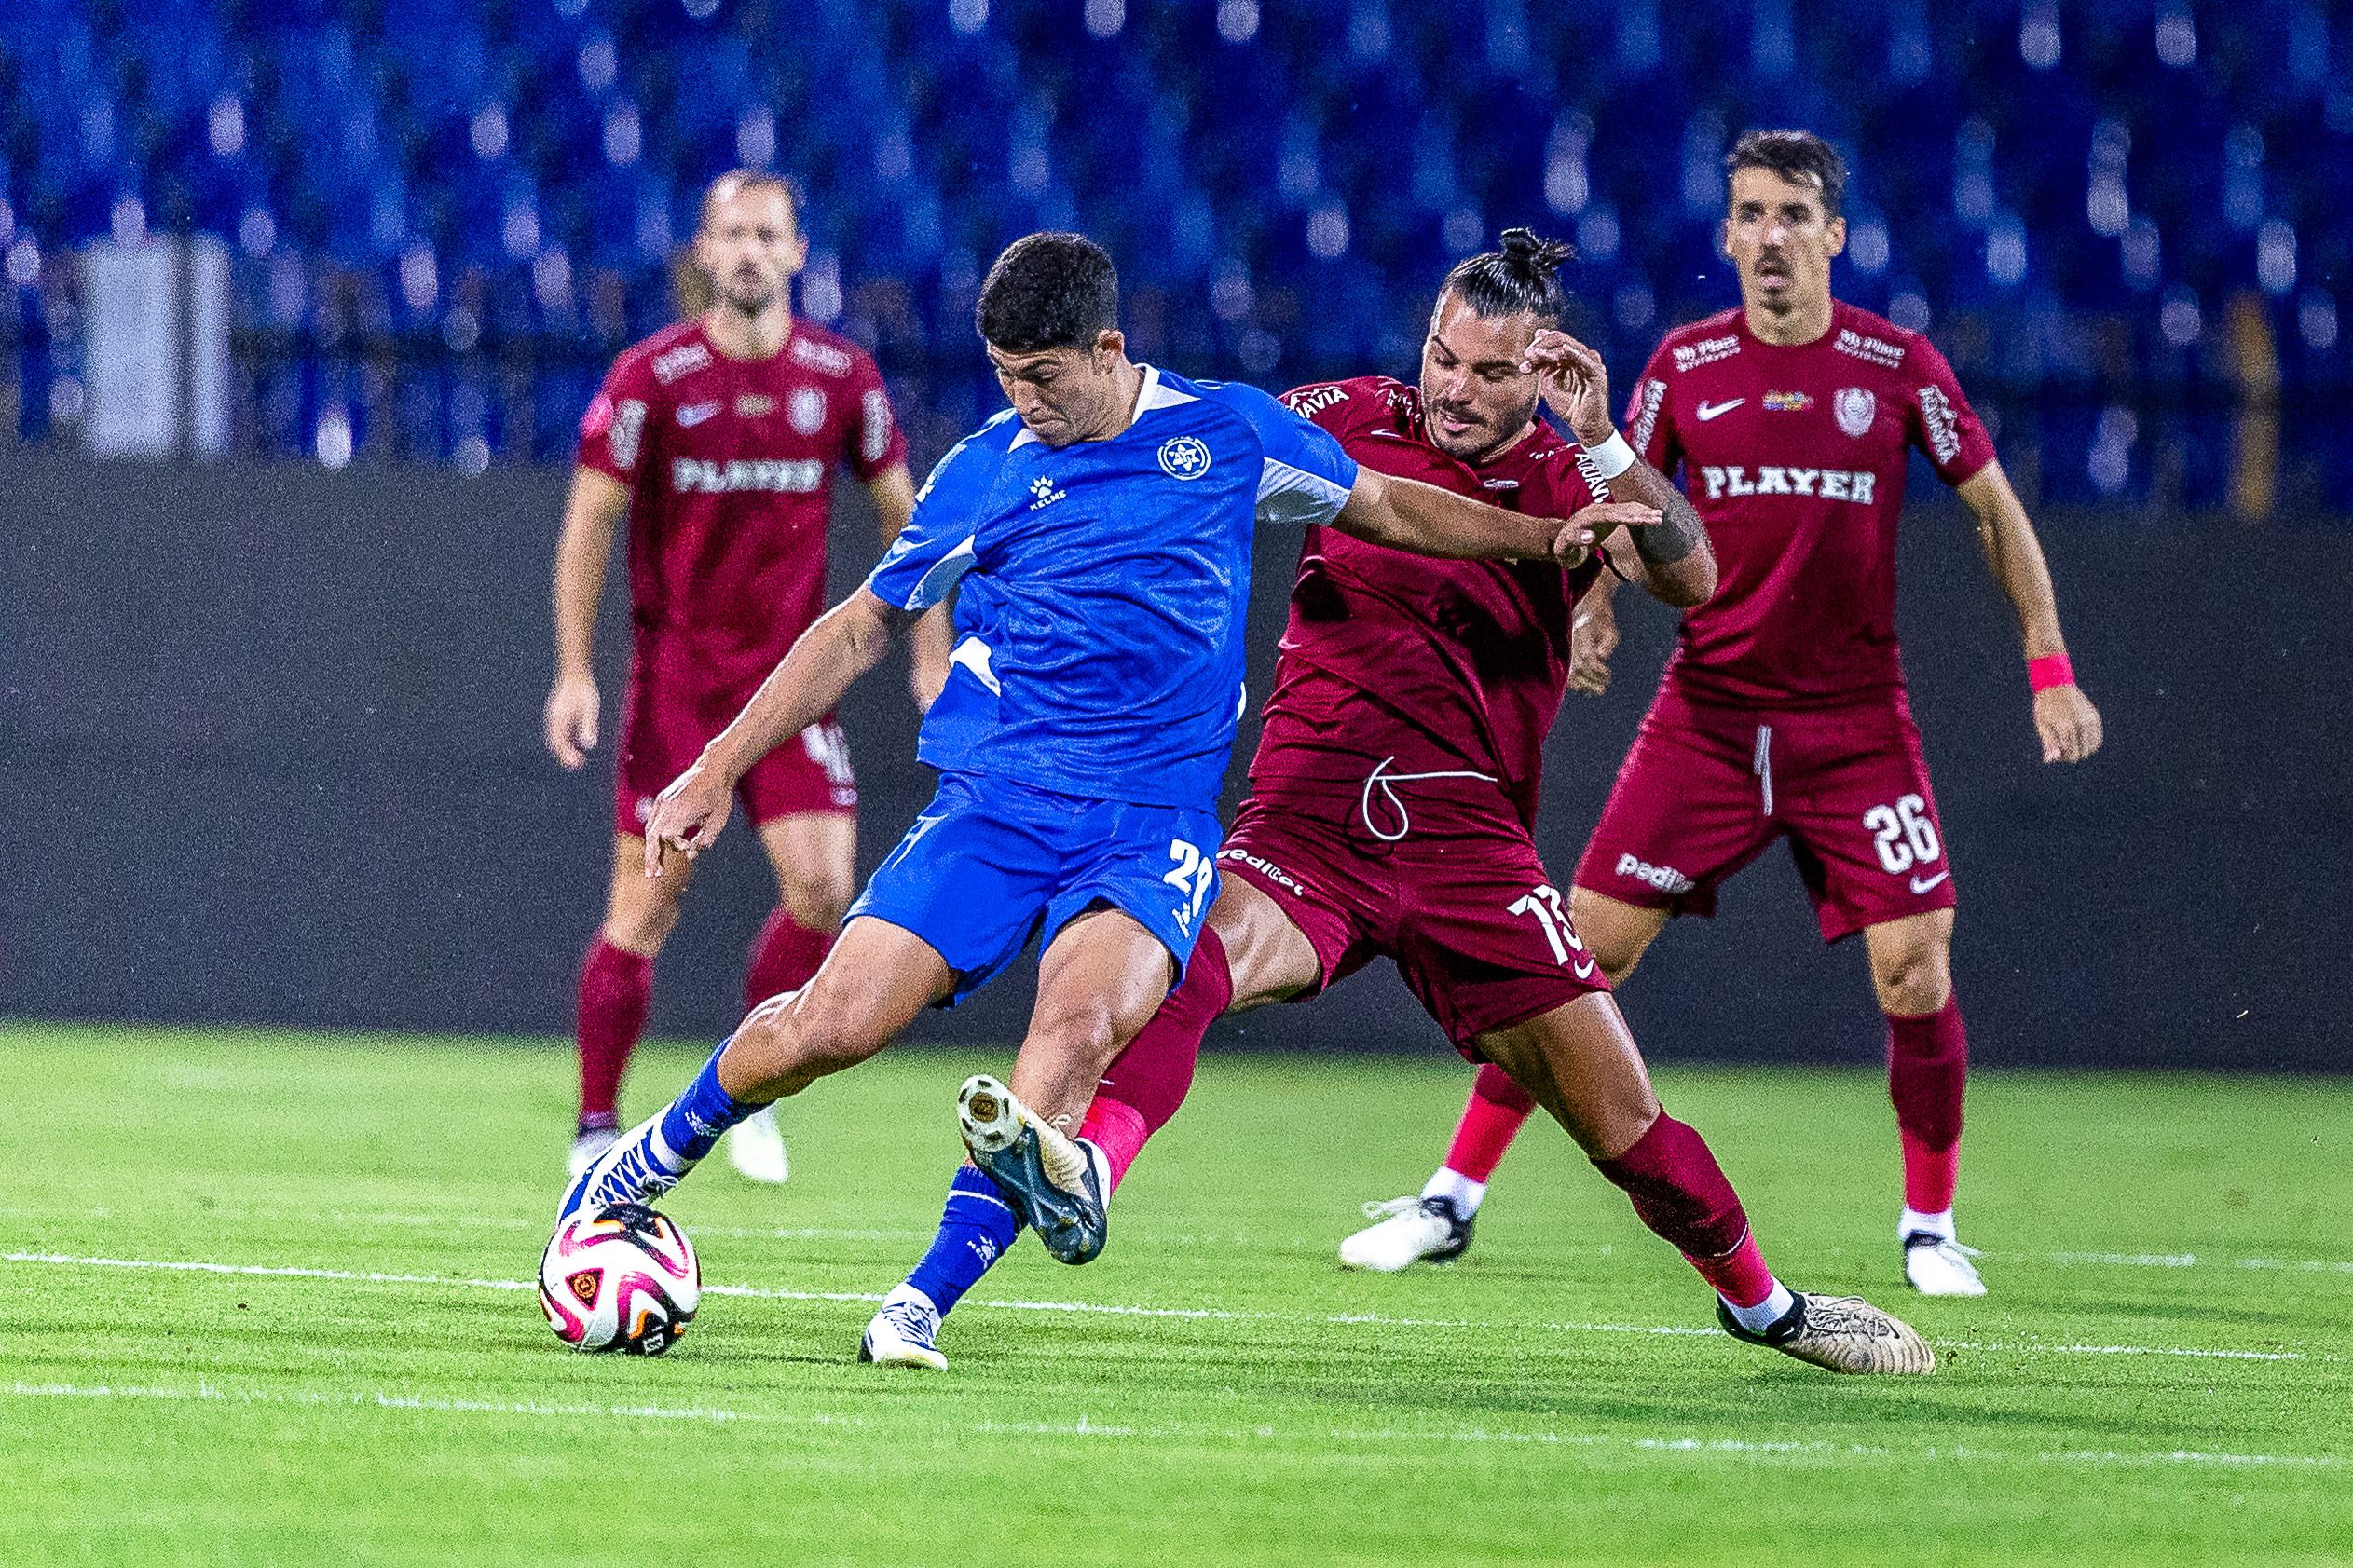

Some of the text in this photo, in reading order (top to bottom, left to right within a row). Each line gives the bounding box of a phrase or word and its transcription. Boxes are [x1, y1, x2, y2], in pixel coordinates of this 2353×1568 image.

[1030, 489, 1067, 511] KELME
[1701, 466, 1876, 506] PLAYER
[1862, 793, 1940, 875] 26
